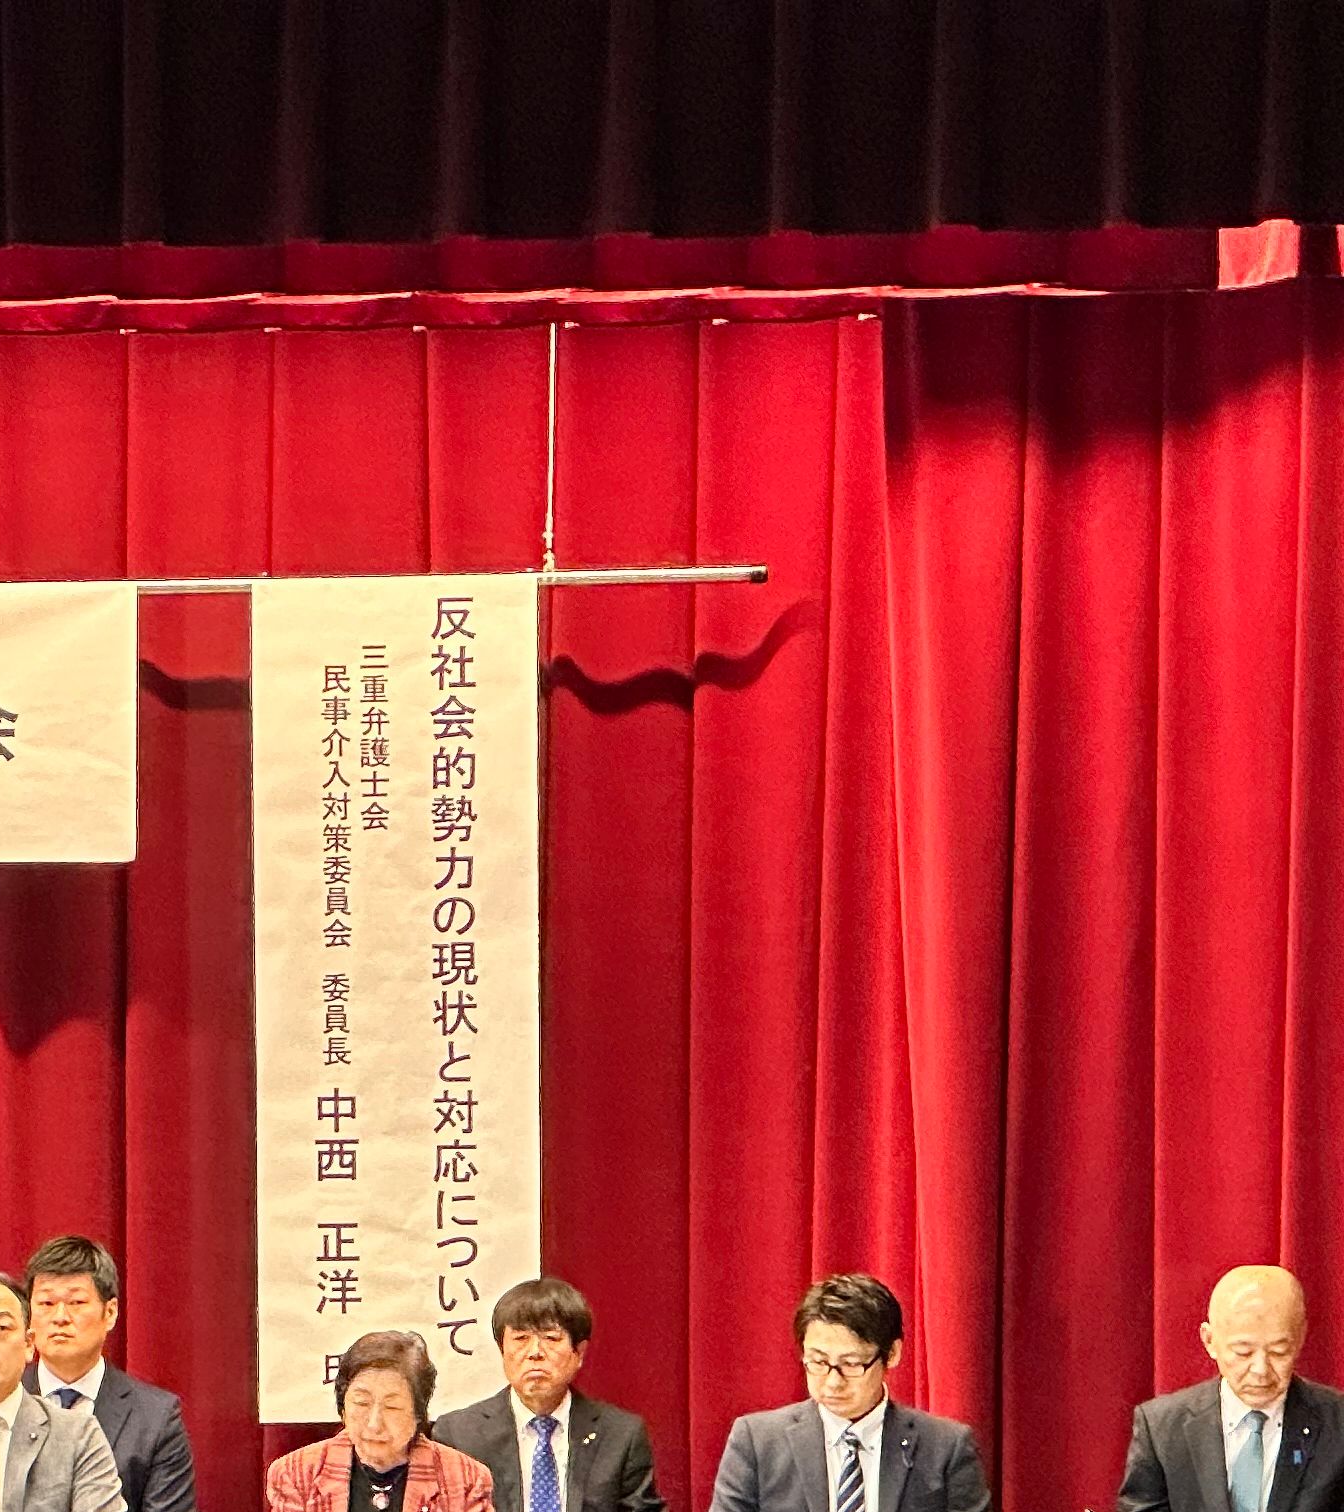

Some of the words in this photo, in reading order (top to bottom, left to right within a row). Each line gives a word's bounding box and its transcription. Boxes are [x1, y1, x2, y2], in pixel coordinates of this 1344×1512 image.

[321, 665, 353, 948] 民事介入対策委員会
[360, 644, 390, 831] 三重弁護士会
[321, 973, 352, 1066] 委員長
[430, 597, 480, 1357] 反社会的勢力の現状と対応について
[315, 1087, 358, 1182] 中西
[316, 1222, 362, 1314] 正洋
